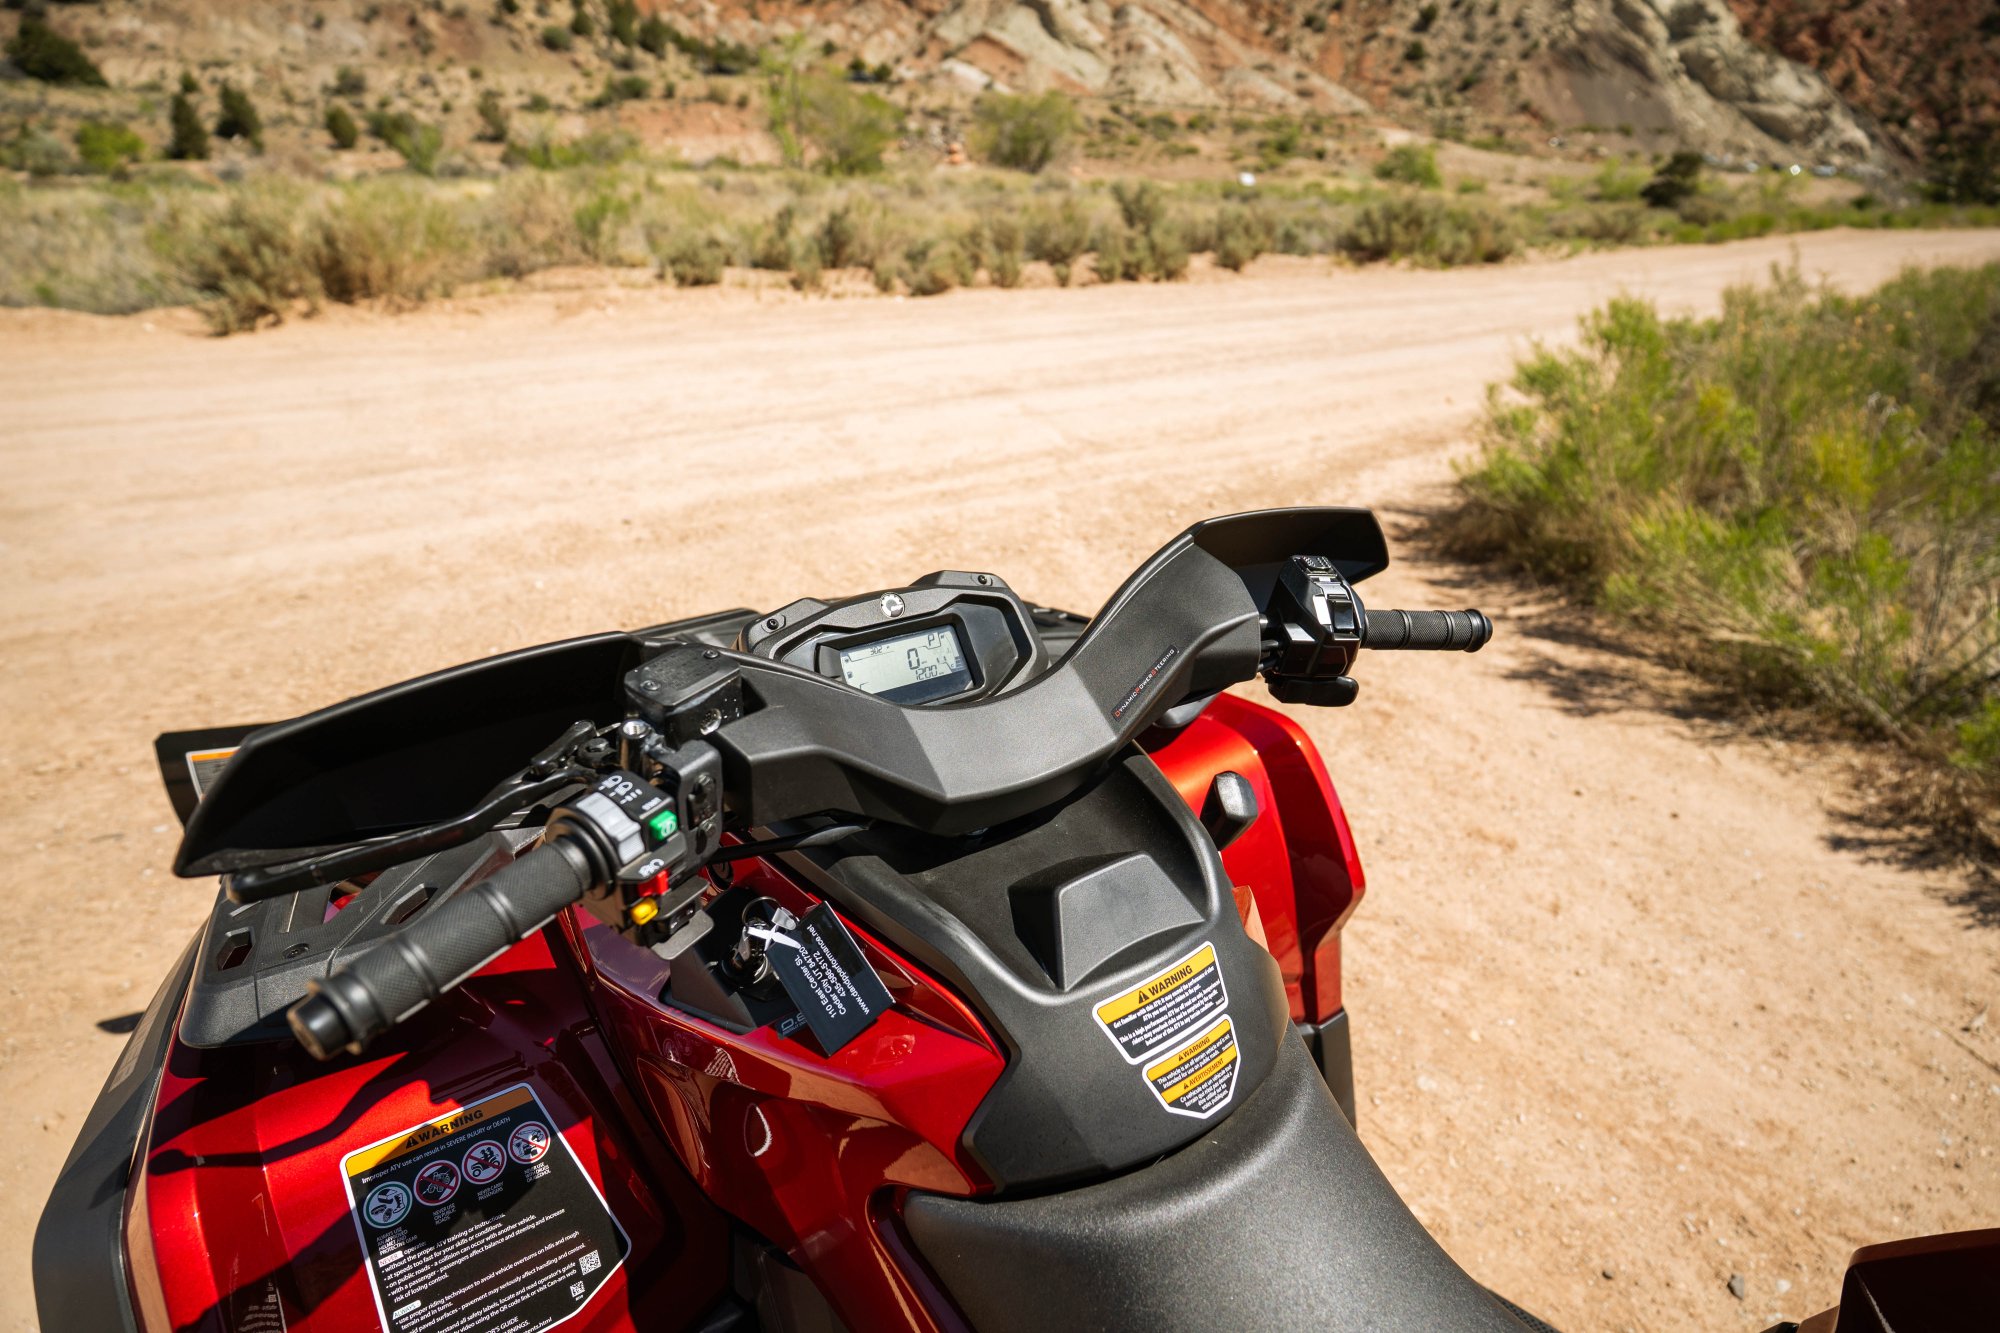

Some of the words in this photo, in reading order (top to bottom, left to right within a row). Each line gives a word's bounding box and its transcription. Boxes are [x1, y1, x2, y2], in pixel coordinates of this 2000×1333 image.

[906, 647, 920, 669] 0
[915, 664, 937, 680] 1200
[794, 954, 802, 966] St.
[807, 924, 869, 1013] www.dandpperformance.net
[812, 968, 822, 979] UT
[813, 950, 845, 996] 435-586-5172
[800, 965, 817, 988] Center
[820, 978, 832, 993] City
[1148, 964, 1193, 996] WARNING
[815, 987, 828, 1005] East
[829, 993, 846, 1014] Cedar
[1158, 1004, 1167, 1012] may
[825, 1004, 836, 1017] 110
[1113, 1020, 1122, 1028] Get
[1120, 1013, 1137, 1024] familiar
[1136, 1008, 1146, 1016] with
[1118, 1035, 1129, 1043] This
[1134, 1026, 1145, 1035] high
[1144, 1014, 1168, 1031] performance
[1131, 1035, 1144, 1045] riders
[1143, 1031, 1152, 1039] may
[1144, 1033, 1162, 1046] behavior
[1182, 1036, 1210, 1057] WARNING
[1157, 1076, 1167, 1084] This
[1166, 1068, 1181, 1079] vehicle
[1162, 1074, 1181, 1088] intended
[1198, 1056, 1210, 1067] public
[1187, 1058, 1225, 1086] AVERTISSEMENT
[418, 1109, 483, 1142] WARNING
[361, 1169, 388, 1183] Improper
[390, 1162, 401, 1171] ATV
[401, 1158, 413, 1166] use
[423, 1146, 439, 1157] result
[446, 1134, 466, 1147] SEVERE
[466, 1127, 485, 1138] INJURY
[492, 1116, 510, 1128] DEATH
[384, 1258, 406, 1272] without
[416, 1246, 434, 1258] proper
[436, 1238, 446, 1248] ATV
[446, 1230, 468, 1242] training
[473, 1213, 505, 1229] instructions.
[390, 1285, 404, 1295] with
[408, 1270, 435, 1288] passenger
[439, 1254, 469, 1272] passengers
[469, 1246, 484, 1257] affect
[483, 1237, 504, 1250] balance
[504, 1231, 515, 1240] and
[514, 1222, 535, 1235] steering
[535, 1216, 545, 1225] and
[544, 1208, 564, 1220] increase
[393, 1264, 412, 1277] speeds
[412, 1259, 423, 1267] too
[423, 1254, 433, 1262] fast
[442, 1244, 454, 1254] your
[455, 1238, 468, 1247] skills
[474, 1222, 502, 1238] conditions.
[397, 1272, 415, 1285] public
[414, 1264, 430, 1275] roads
[438, 1250, 460, 1264] collision
[460, 1245, 470, 1253] can
[470, 1238, 484, 1248] occur
[485, 1232, 497, 1241] with
[497, 1223, 517, 1235] another
[517, 1214, 536, 1225] vehicle.
[393, 1294, 404, 1303] risk
[404, 1289, 410, 1297] of
[410, 1283, 428, 1294] losing
[428, 1272, 448, 1285] control.
[398, 1316, 408, 1324] use
[409, 1306, 429, 1319] proper
[428, 1298, 444, 1309] riding
[444, 1283, 473, 1300] techniques
[480, 1271, 495, 1283] avoid
[495, 1263, 513, 1275] vehicle
[513, 1251, 537, 1266] overturns
[544, 1242, 554, 1250] hills
[554, 1237, 564, 1246] and
[564, 1230, 579, 1240] rough
[418, 1318, 435, 1332] paved
[435, 1308, 458, 1322] surfaces
[461, 1292, 487, 1310] pavement
[487, 1286, 499, 1295] may
[499, 1275, 521, 1290] seriously
[521, 1268, 536, 1278] affect
[535, 1257, 558, 1271] handling
[557, 1251, 567, 1260] and
[567, 1242, 585, 1255] control.
[459, 1322, 475, 1332] video
[475, 1314, 490, 1324] using
[489, 1309, 499, 1317] the
[507, 1298, 520, 1307] code
[520, 1292, 530, 1301] link
[536, 1284, 547, 1292] visit
[546, 1275, 566, 1287] Can-am
[565, 1269, 576, 1277] web
[467, 1309, 482, 1321] safety
[482, 1301, 499, 1312] labels,
[499, 1293, 515, 1304] locate
[515, 1287, 525, 1296] and
[525, 1281, 537, 1290] read
[537, 1269, 561, 1284] operator's
[561, 1262, 575, 1273] guide
[394, 1302, 417, 1318] ALWAYS
[401, 1318, 419, 1330] terrain
[420, 1310, 431, 1320] and
[437, 1301, 453, 1311] turns.
[500, 1315, 518, 1329] GUIDE
